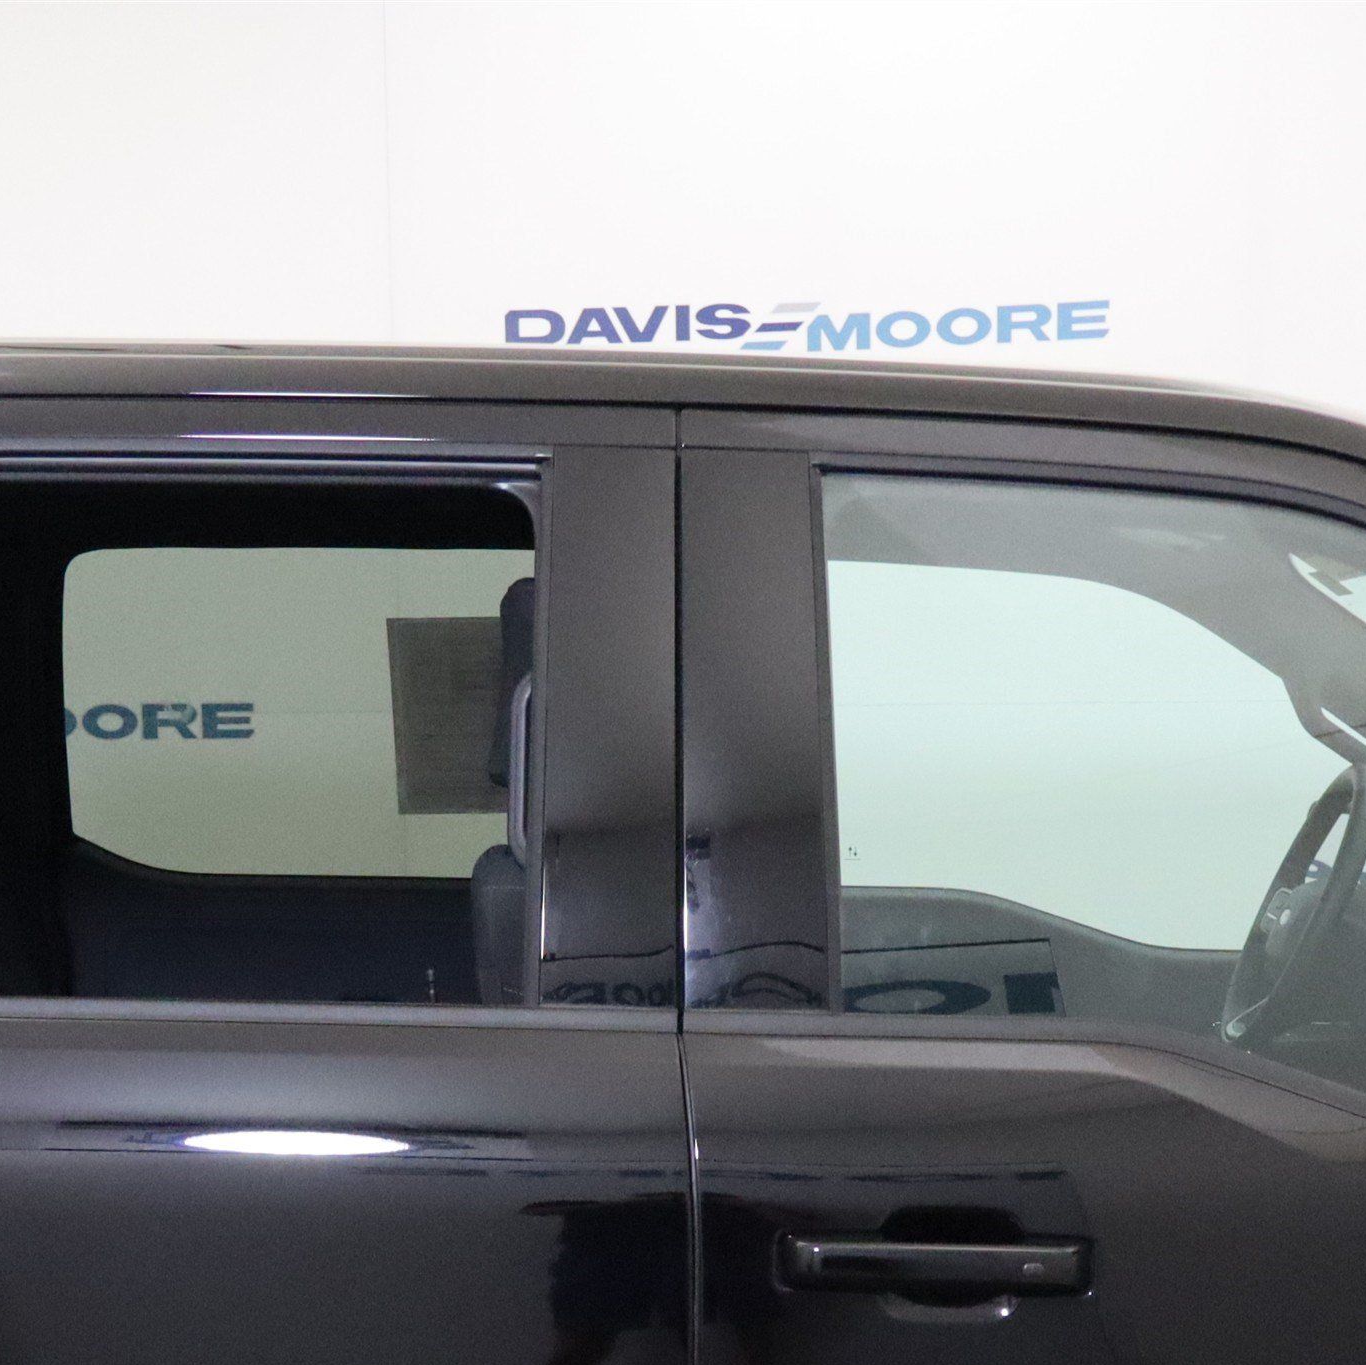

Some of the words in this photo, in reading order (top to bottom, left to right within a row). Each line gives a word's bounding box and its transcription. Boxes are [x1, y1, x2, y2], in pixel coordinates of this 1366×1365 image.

[504, 302, 751, 344] DAVIS
[807, 299, 1110, 352] MOORE
[64, 702, 254, 740] ORE
